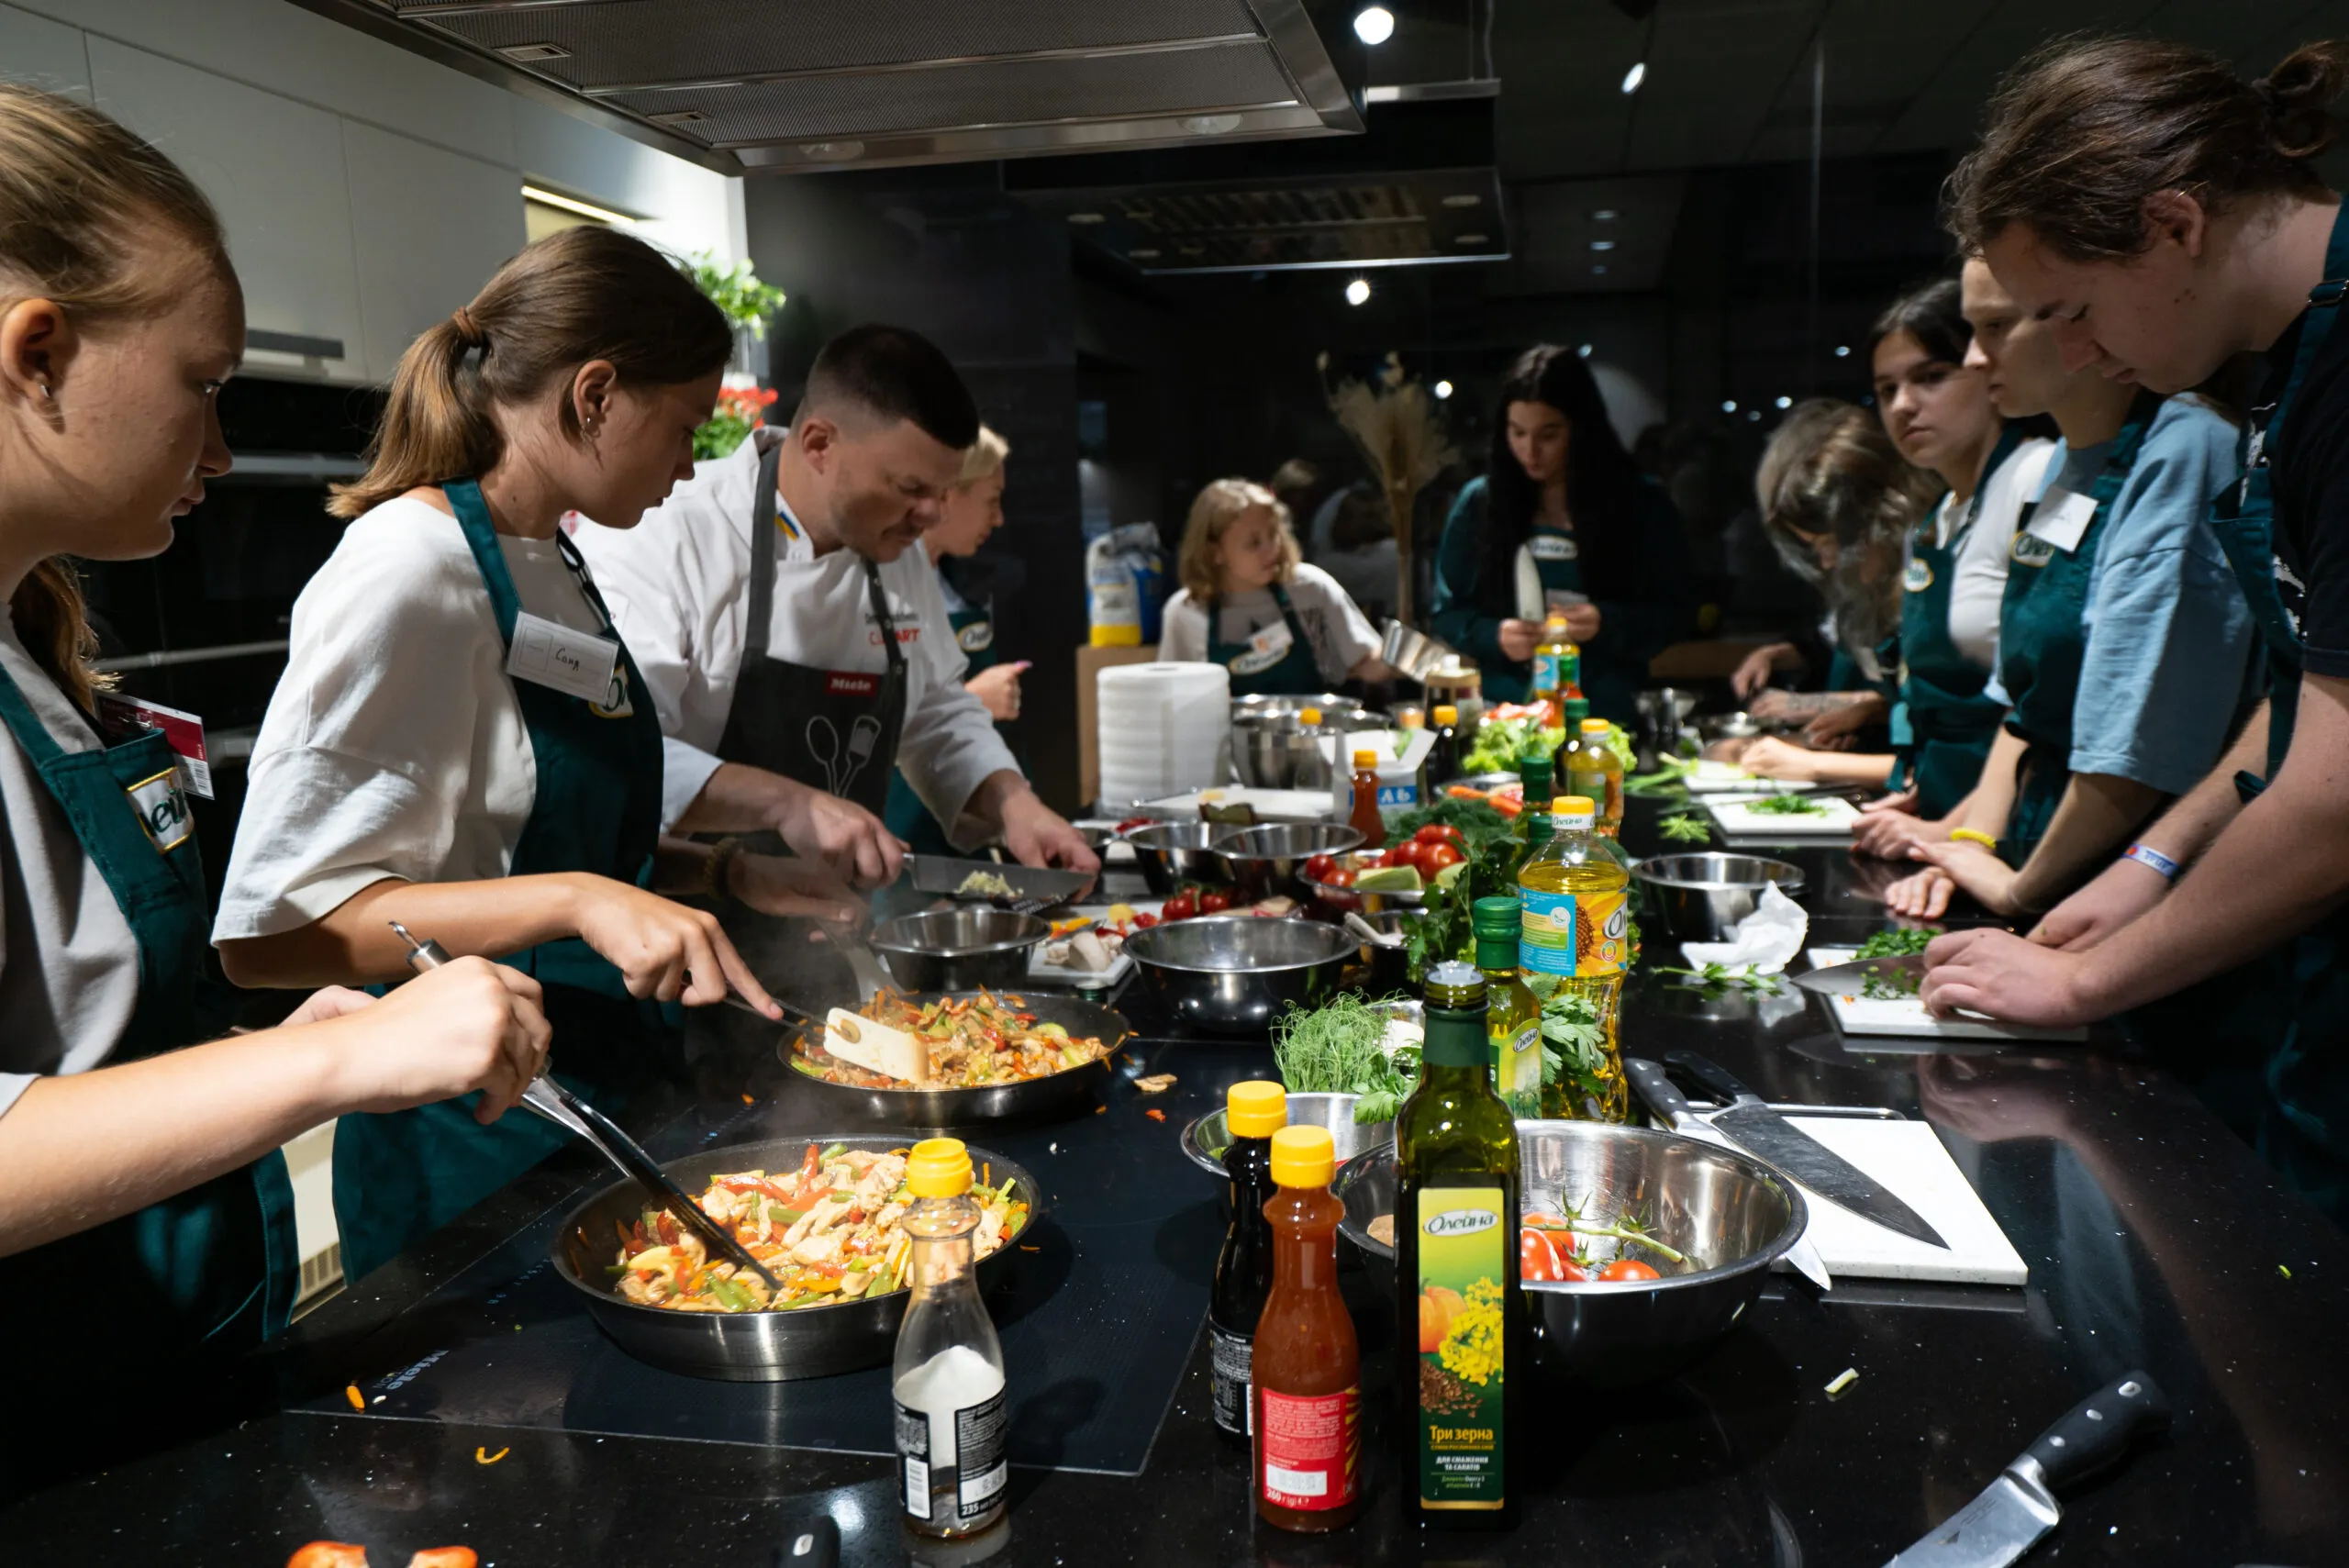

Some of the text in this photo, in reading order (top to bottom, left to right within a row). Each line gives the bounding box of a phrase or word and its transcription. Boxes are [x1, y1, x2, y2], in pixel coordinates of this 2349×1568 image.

[831, 678, 872, 691] Miele
[1428, 1215, 1494, 1234] Олейна
[1429, 1425, 1494, 1443] Три зерна
